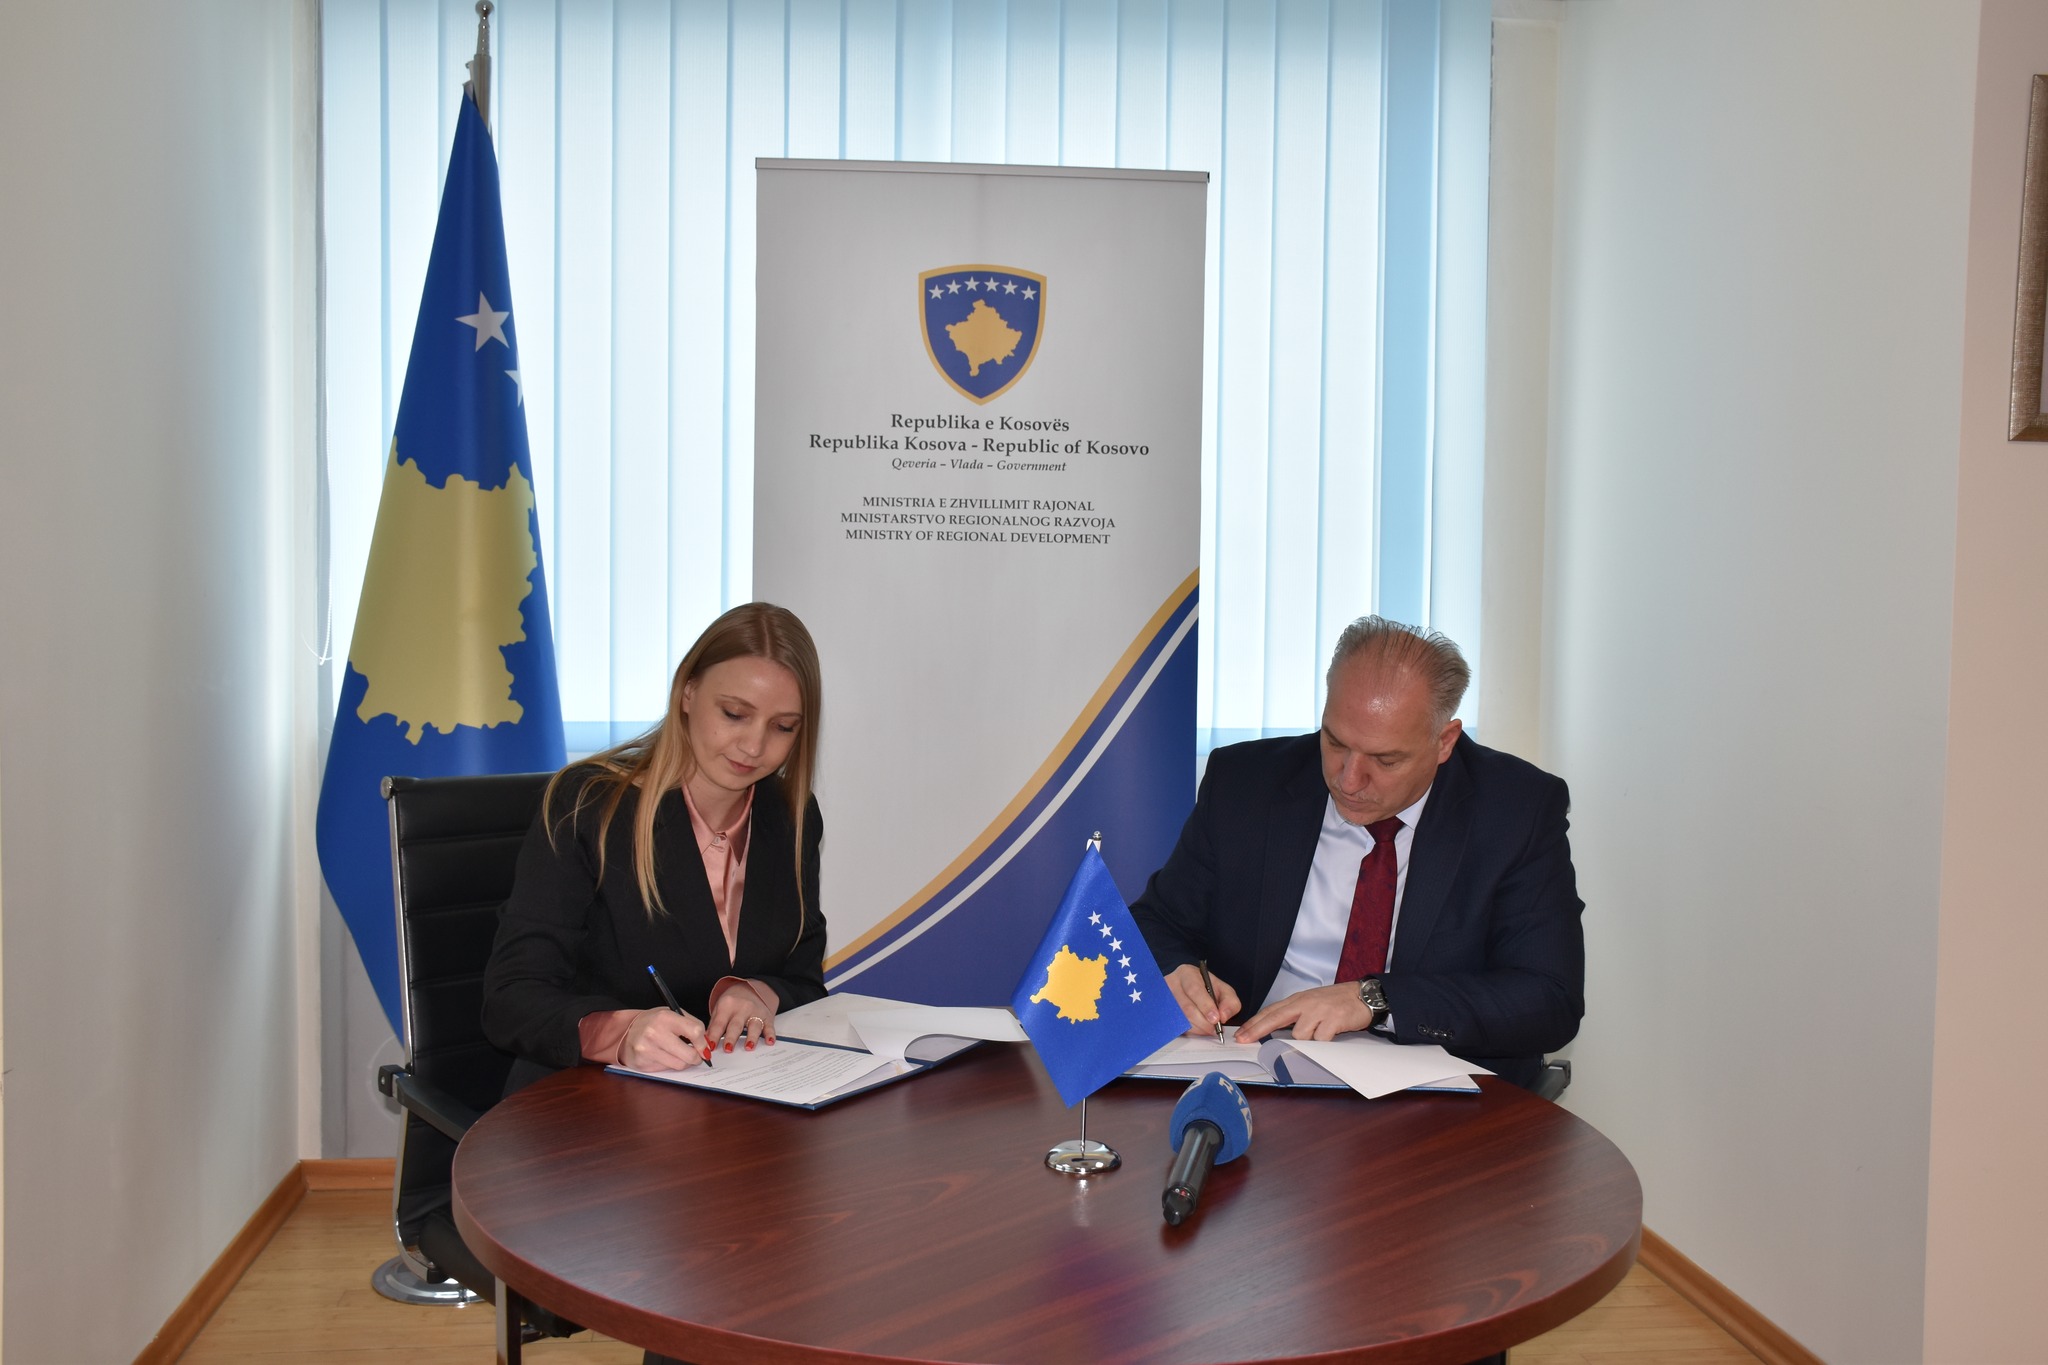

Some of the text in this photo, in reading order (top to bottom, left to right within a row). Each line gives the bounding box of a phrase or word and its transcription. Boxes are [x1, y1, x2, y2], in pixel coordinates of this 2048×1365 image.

[890, 413, 1070, 433] Republika e Kosovës
[809, 433, 900, 454] Republika
[904, 435, 967, 452] Kosova
[982, 437, 1060, 457] Republic
[1063, 439, 1082, 455] of
[1086, 440, 1150, 456] Kosovo
[891, 457, 937, 471] Qeveria
[950, 458, 984, 470] Vlada
[996, 459, 1067, 472] Government
[862, 496, 1095, 513] MINISTRIA E ZHVILLIMIT RAJONAL
[840, 512, 1116, 531] MINISTARSTVO REGIONALNOG RAZVOJA
[845, 529, 1111, 545] MINISTRY OF REGIONAL DEVELOPMENT
